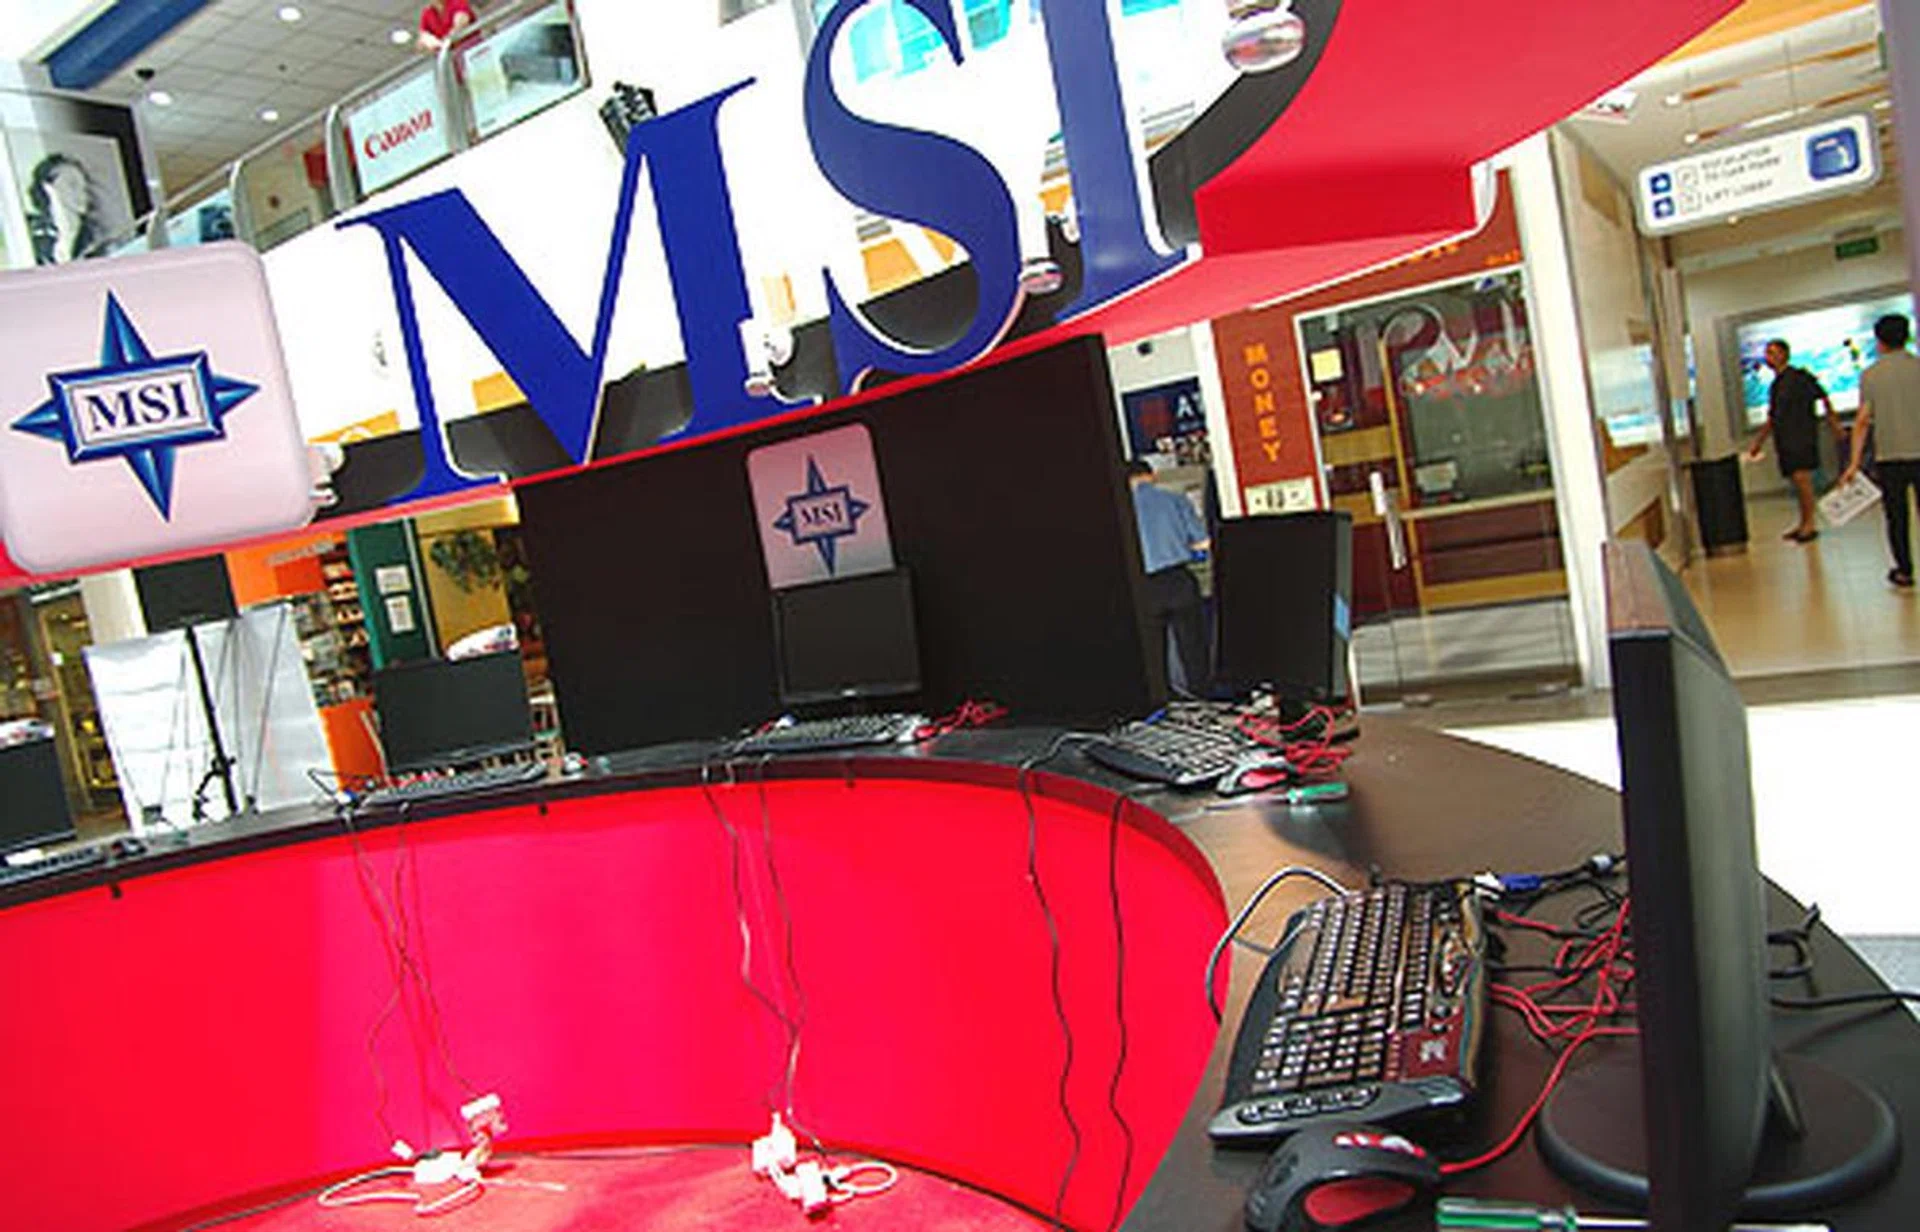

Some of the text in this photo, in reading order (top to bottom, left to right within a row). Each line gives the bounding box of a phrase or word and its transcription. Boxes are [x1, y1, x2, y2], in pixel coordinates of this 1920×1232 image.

[363, 109, 433, 160] Canon
[335, 0, 1189, 505] MSI
[85, 382, 191, 432] MSI
[1243, 343, 1282, 463] MONEY
[800, 502, 843, 526] MSI
